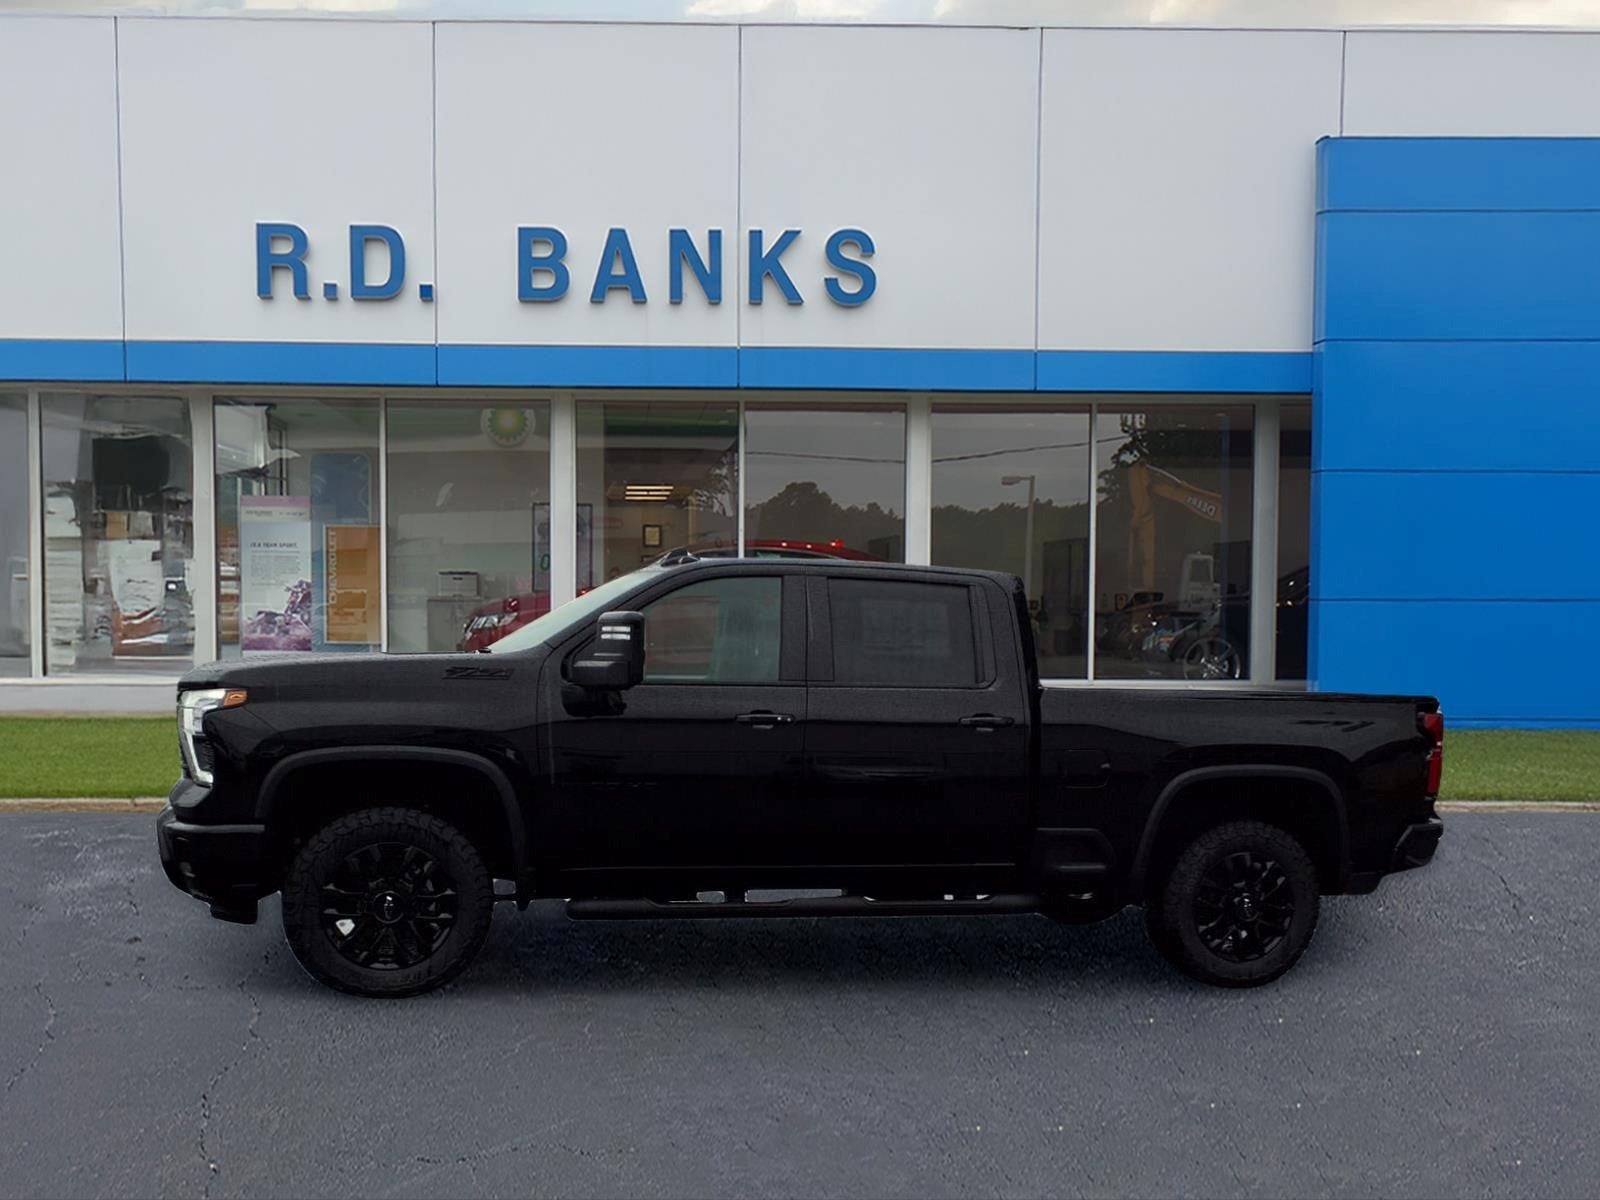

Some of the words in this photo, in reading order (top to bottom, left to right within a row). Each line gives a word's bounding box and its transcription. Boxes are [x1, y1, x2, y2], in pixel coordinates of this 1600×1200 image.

[255, 222, 435, 302] R.D.
[516, 227, 878, 308] BANKS
[328, 528, 337, 604] CHEVROLET
